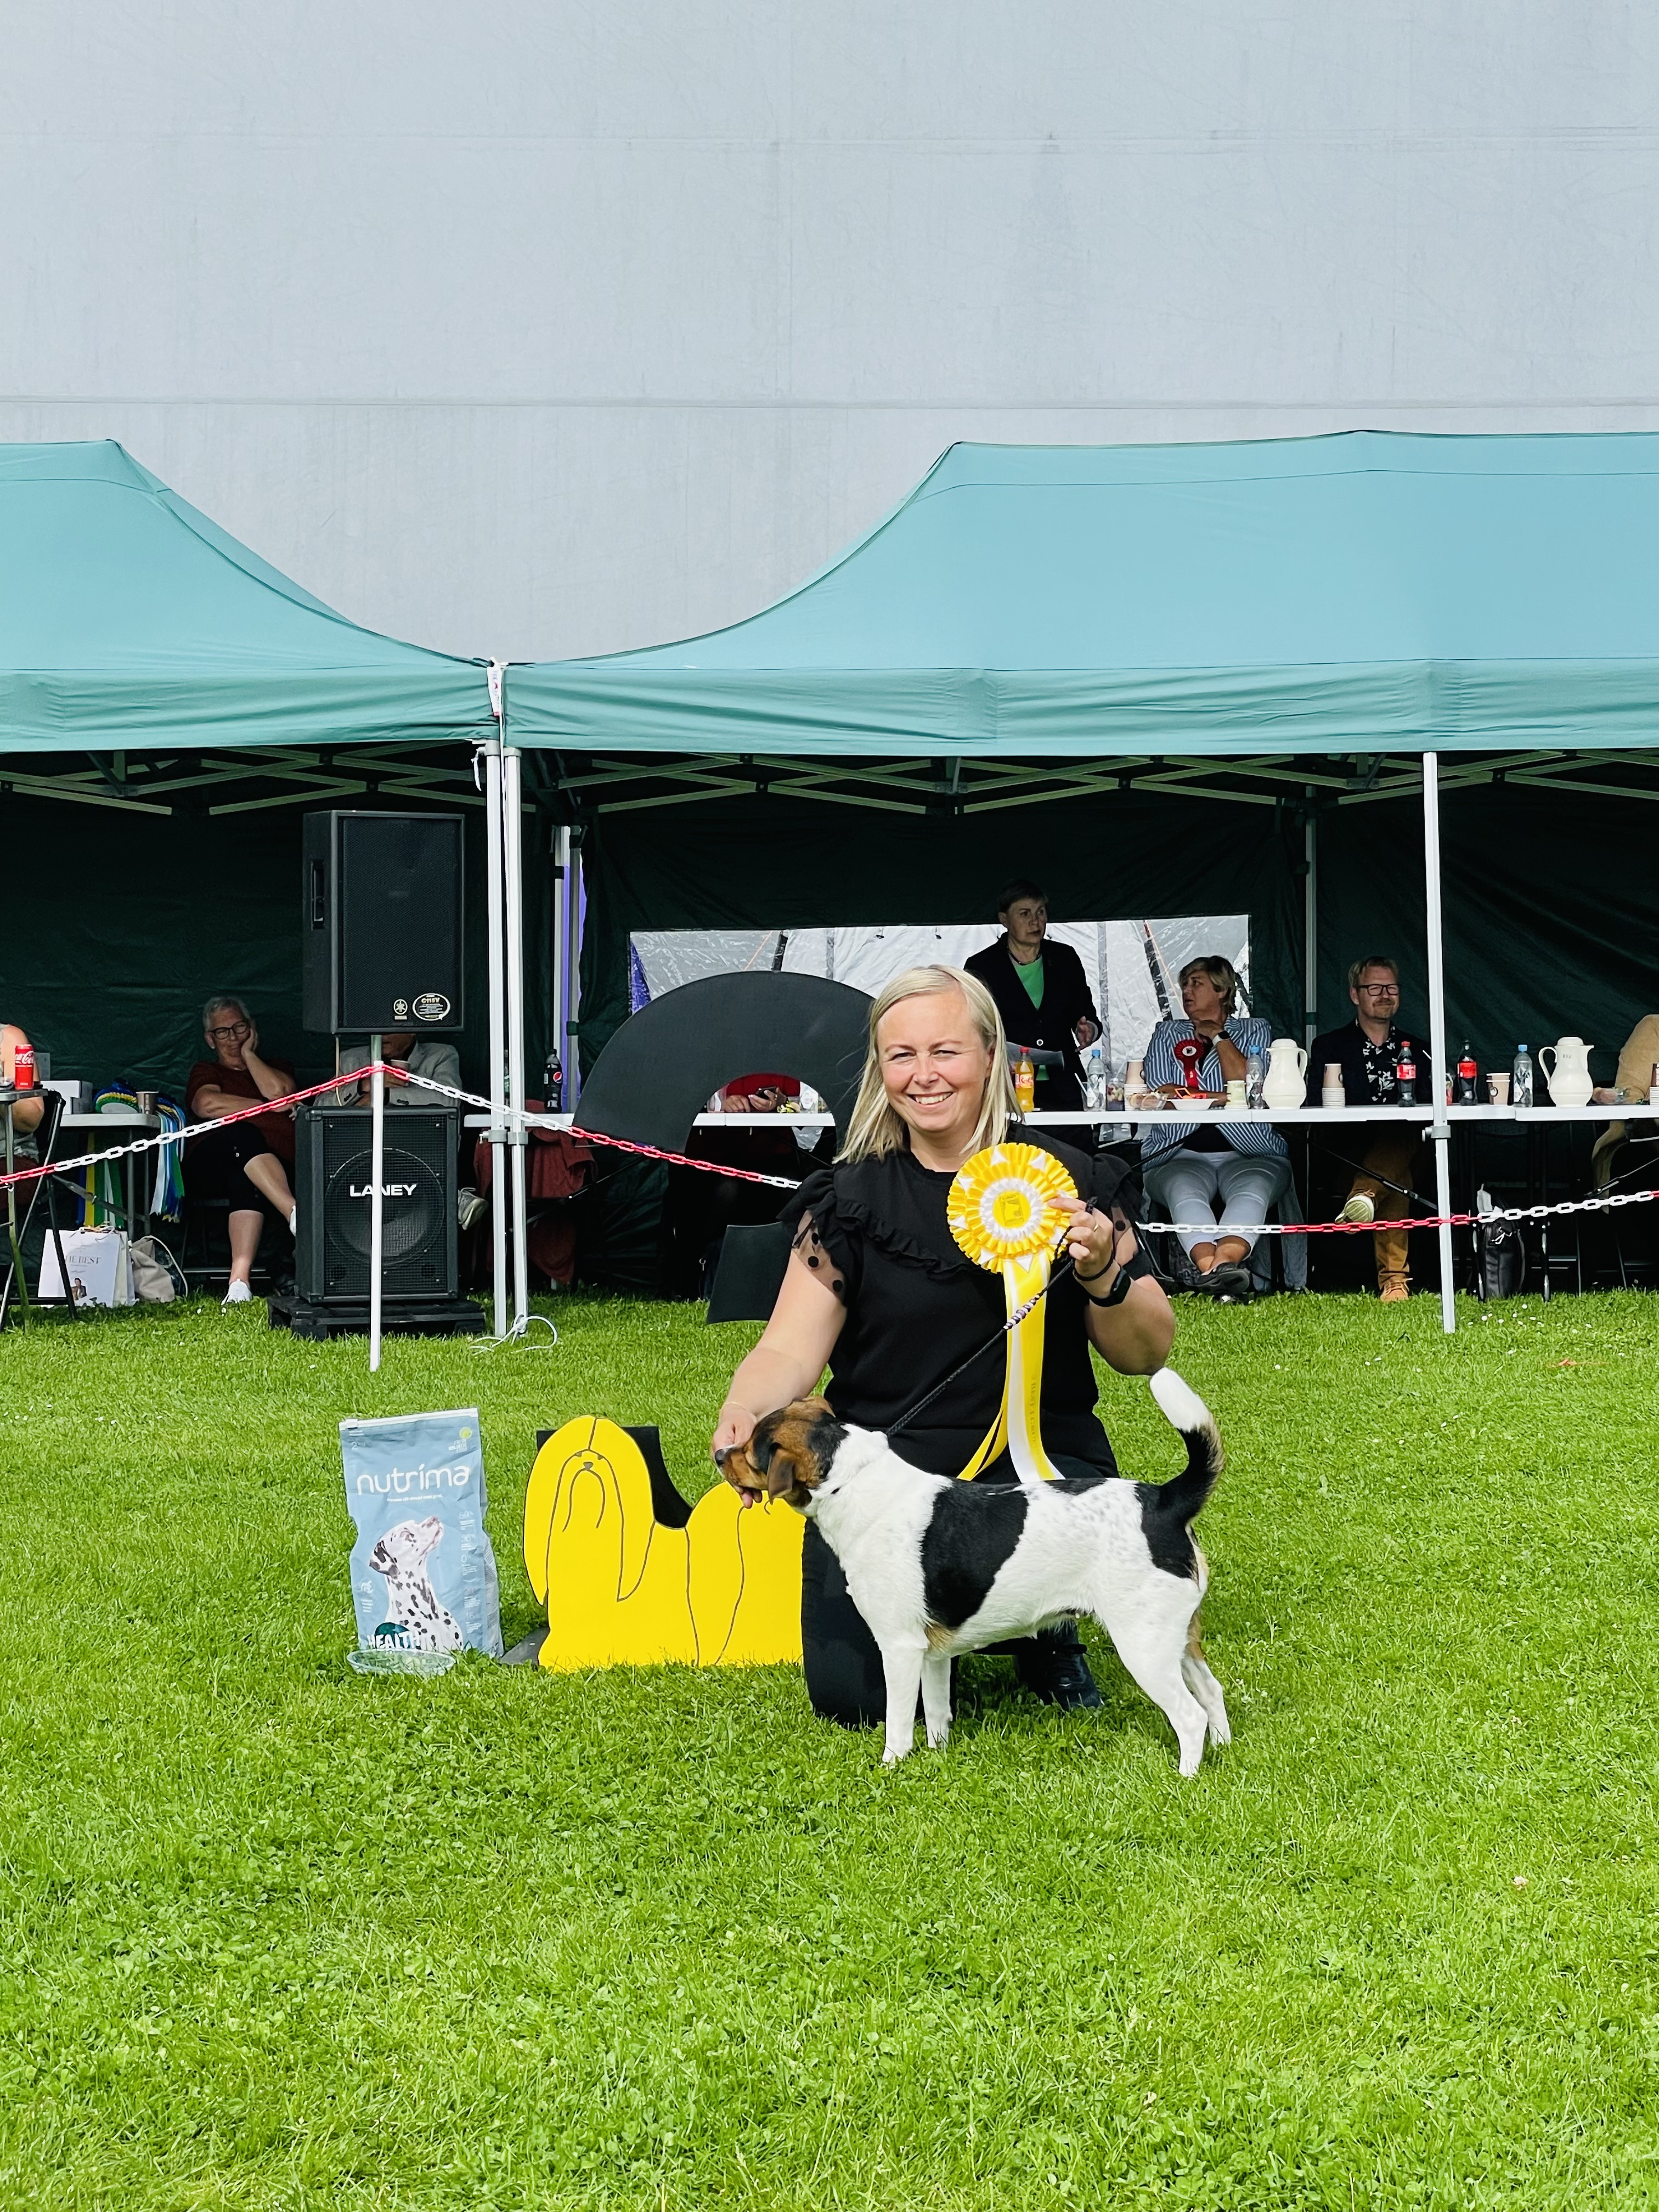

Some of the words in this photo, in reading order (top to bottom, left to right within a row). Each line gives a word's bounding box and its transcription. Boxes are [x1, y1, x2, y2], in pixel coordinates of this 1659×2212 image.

[350, 1184, 417, 1197] LANEY
[78, 1256, 101, 1265] BEST
[366, 1630, 421, 1651] HEALTH
